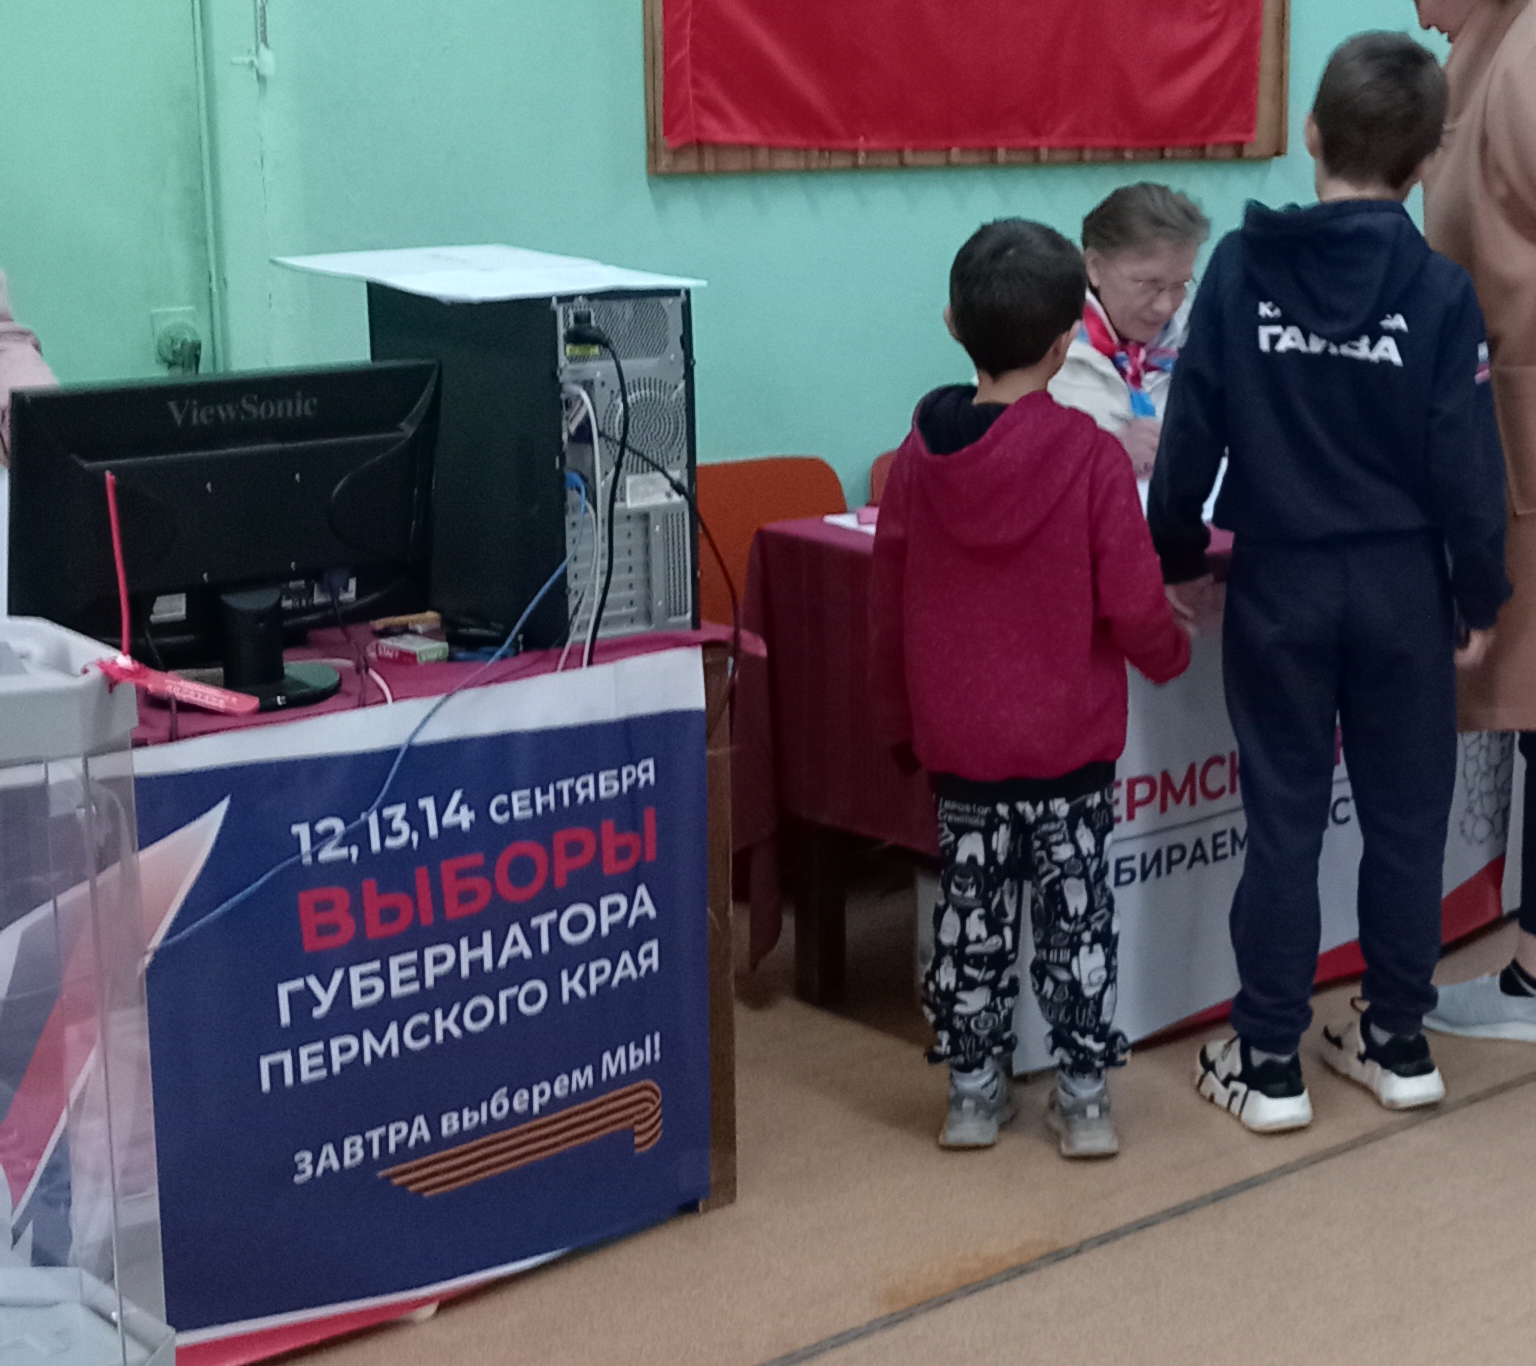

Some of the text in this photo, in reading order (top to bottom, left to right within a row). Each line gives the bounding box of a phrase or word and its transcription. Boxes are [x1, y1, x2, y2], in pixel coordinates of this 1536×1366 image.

[168, 390, 317, 426] ViewSonic
[489, 757, 656, 824] СЕНТЯБРЯ
[298, 806, 657, 953] ВЫБОРЫ
[259, 938, 660, 1094] ПЕРМСКОГО КРАЯ
[277, 883, 658, 1028] ГУБЕРНАТОРА
[293, 1031, 661, 1184] ЗАВТРА выберем МЫ!
